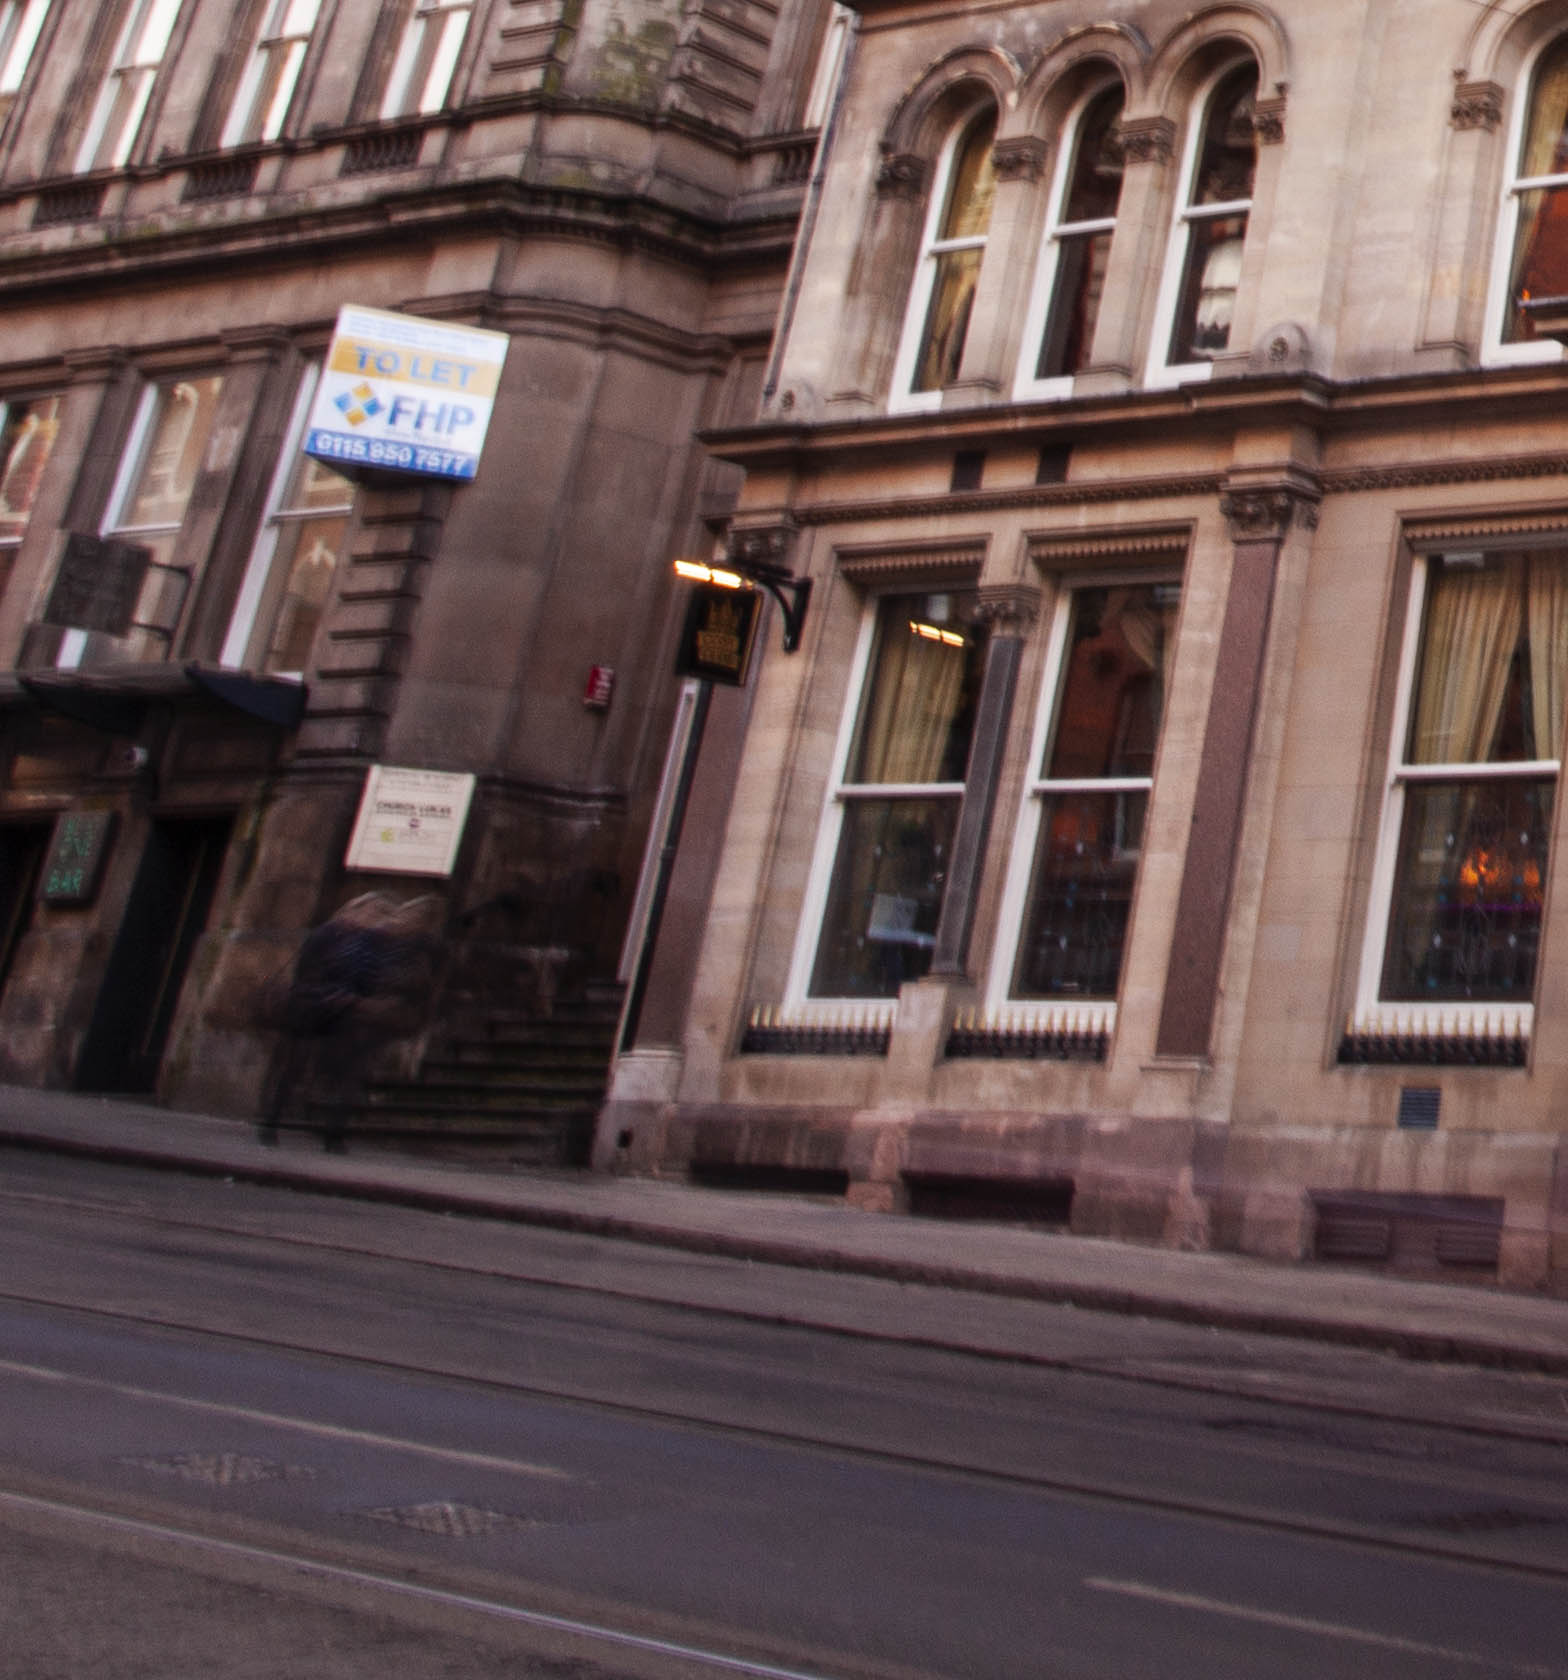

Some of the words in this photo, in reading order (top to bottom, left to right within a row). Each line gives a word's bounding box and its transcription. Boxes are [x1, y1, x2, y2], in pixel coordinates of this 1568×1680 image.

[354, 345, 401, 374] TO
[410, 357, 476, 387] LET
[387, 395, 475, 434] FHP
[315, 432, 367, 457] 0115
